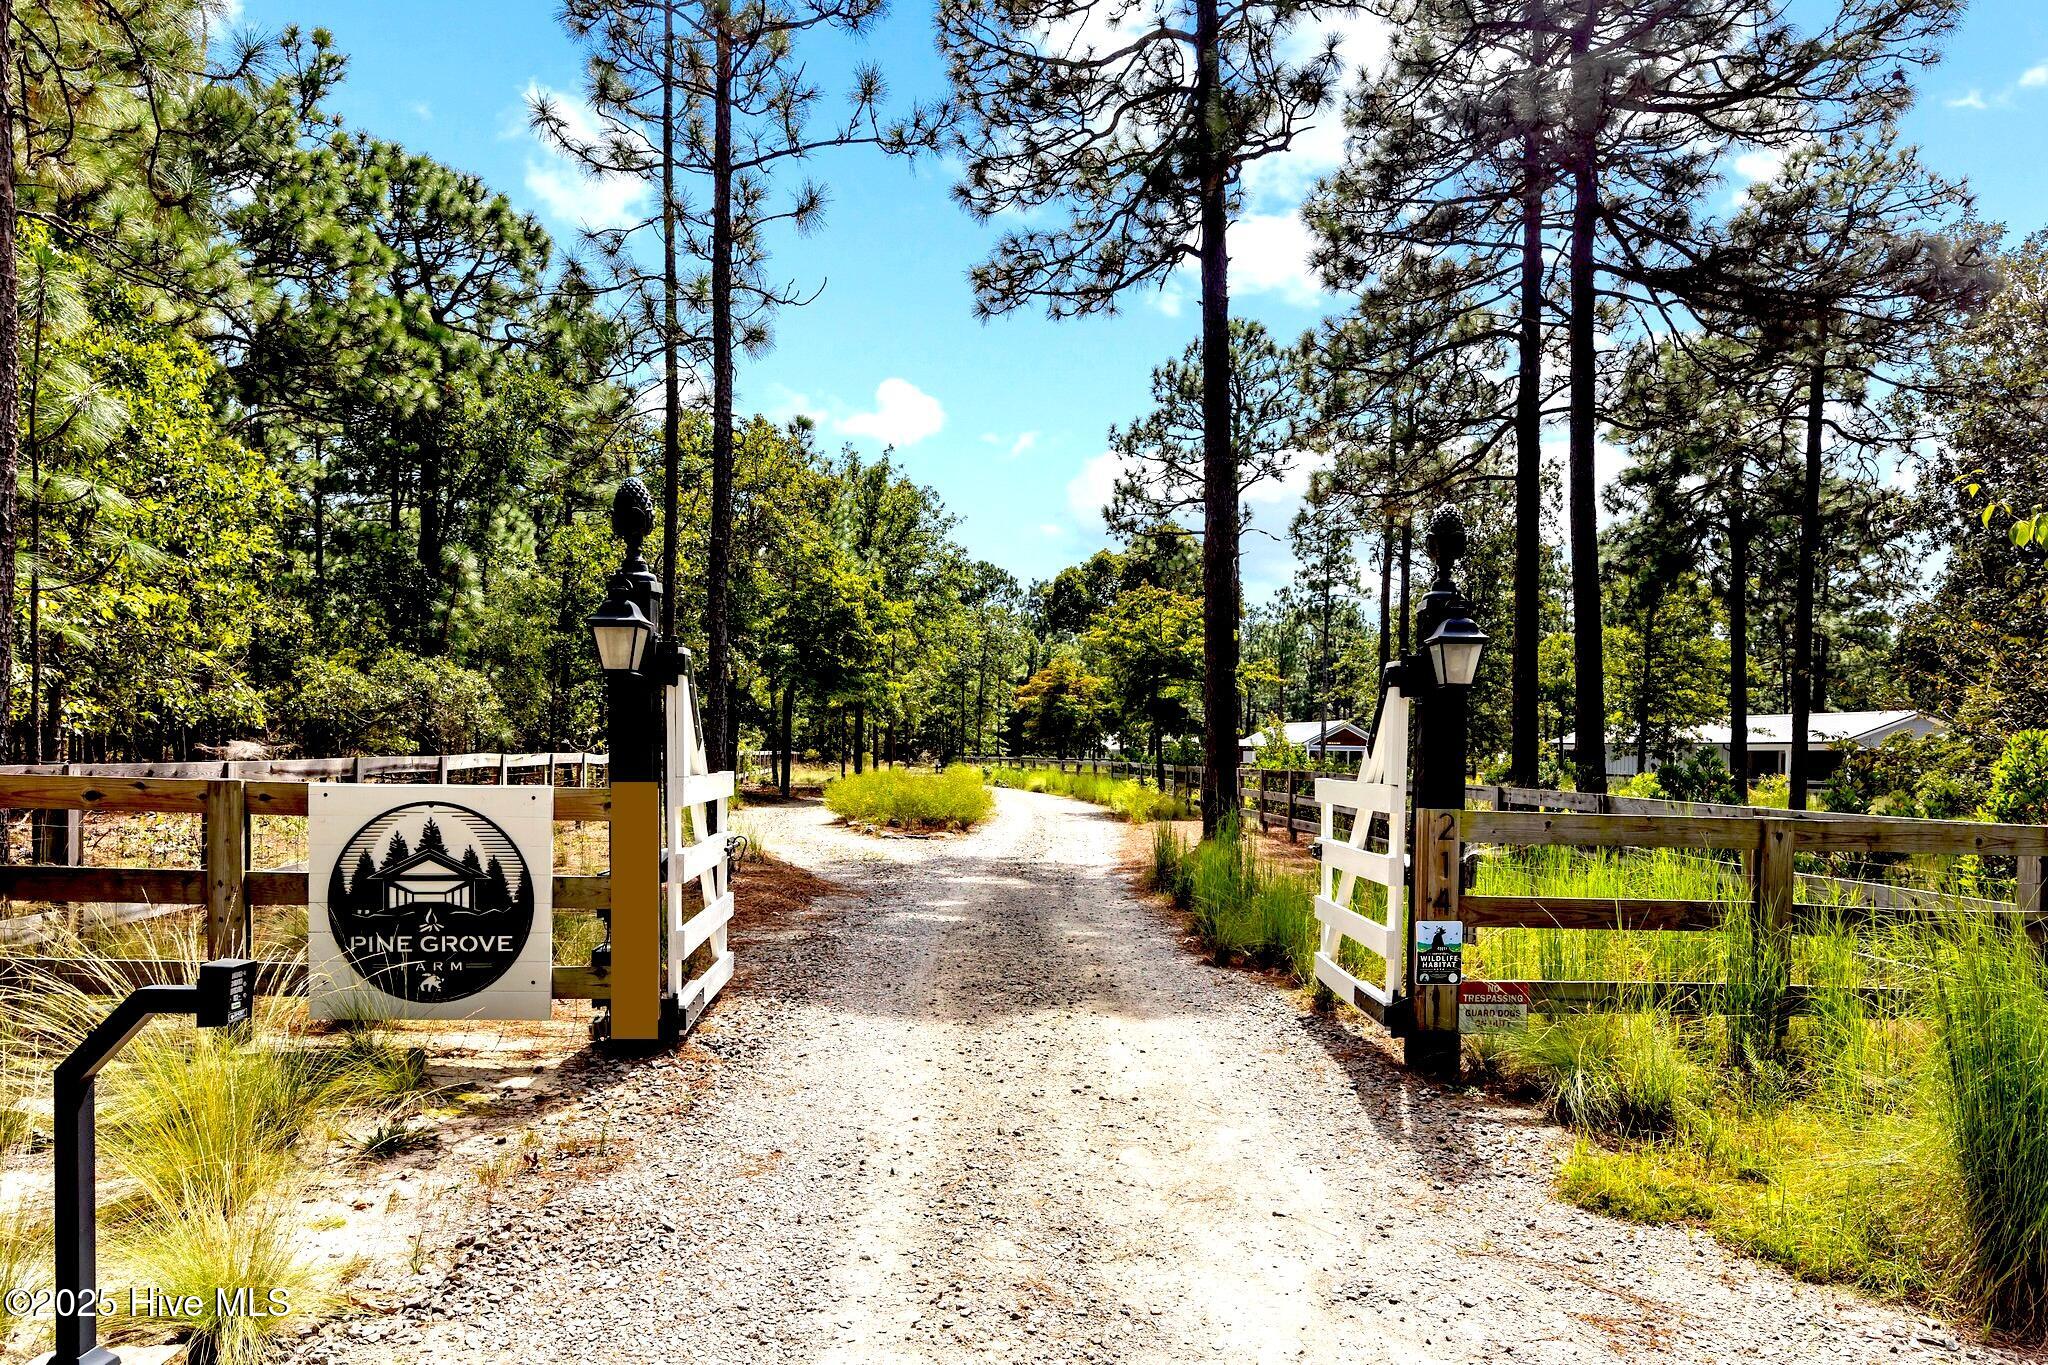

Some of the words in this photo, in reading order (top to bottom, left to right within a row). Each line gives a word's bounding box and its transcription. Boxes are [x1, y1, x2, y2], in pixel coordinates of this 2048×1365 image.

[350, 935, 413, 953] PINE
[420, 935, 514, 953] GROVE
[1487, 984, 1501, 993] NO
[1463, 994, 1523, 1003] TRESPASSING
[1465, 1009, 1496, 1017] GUARD
[1497, 1009, 1521, 1017] DOGS
